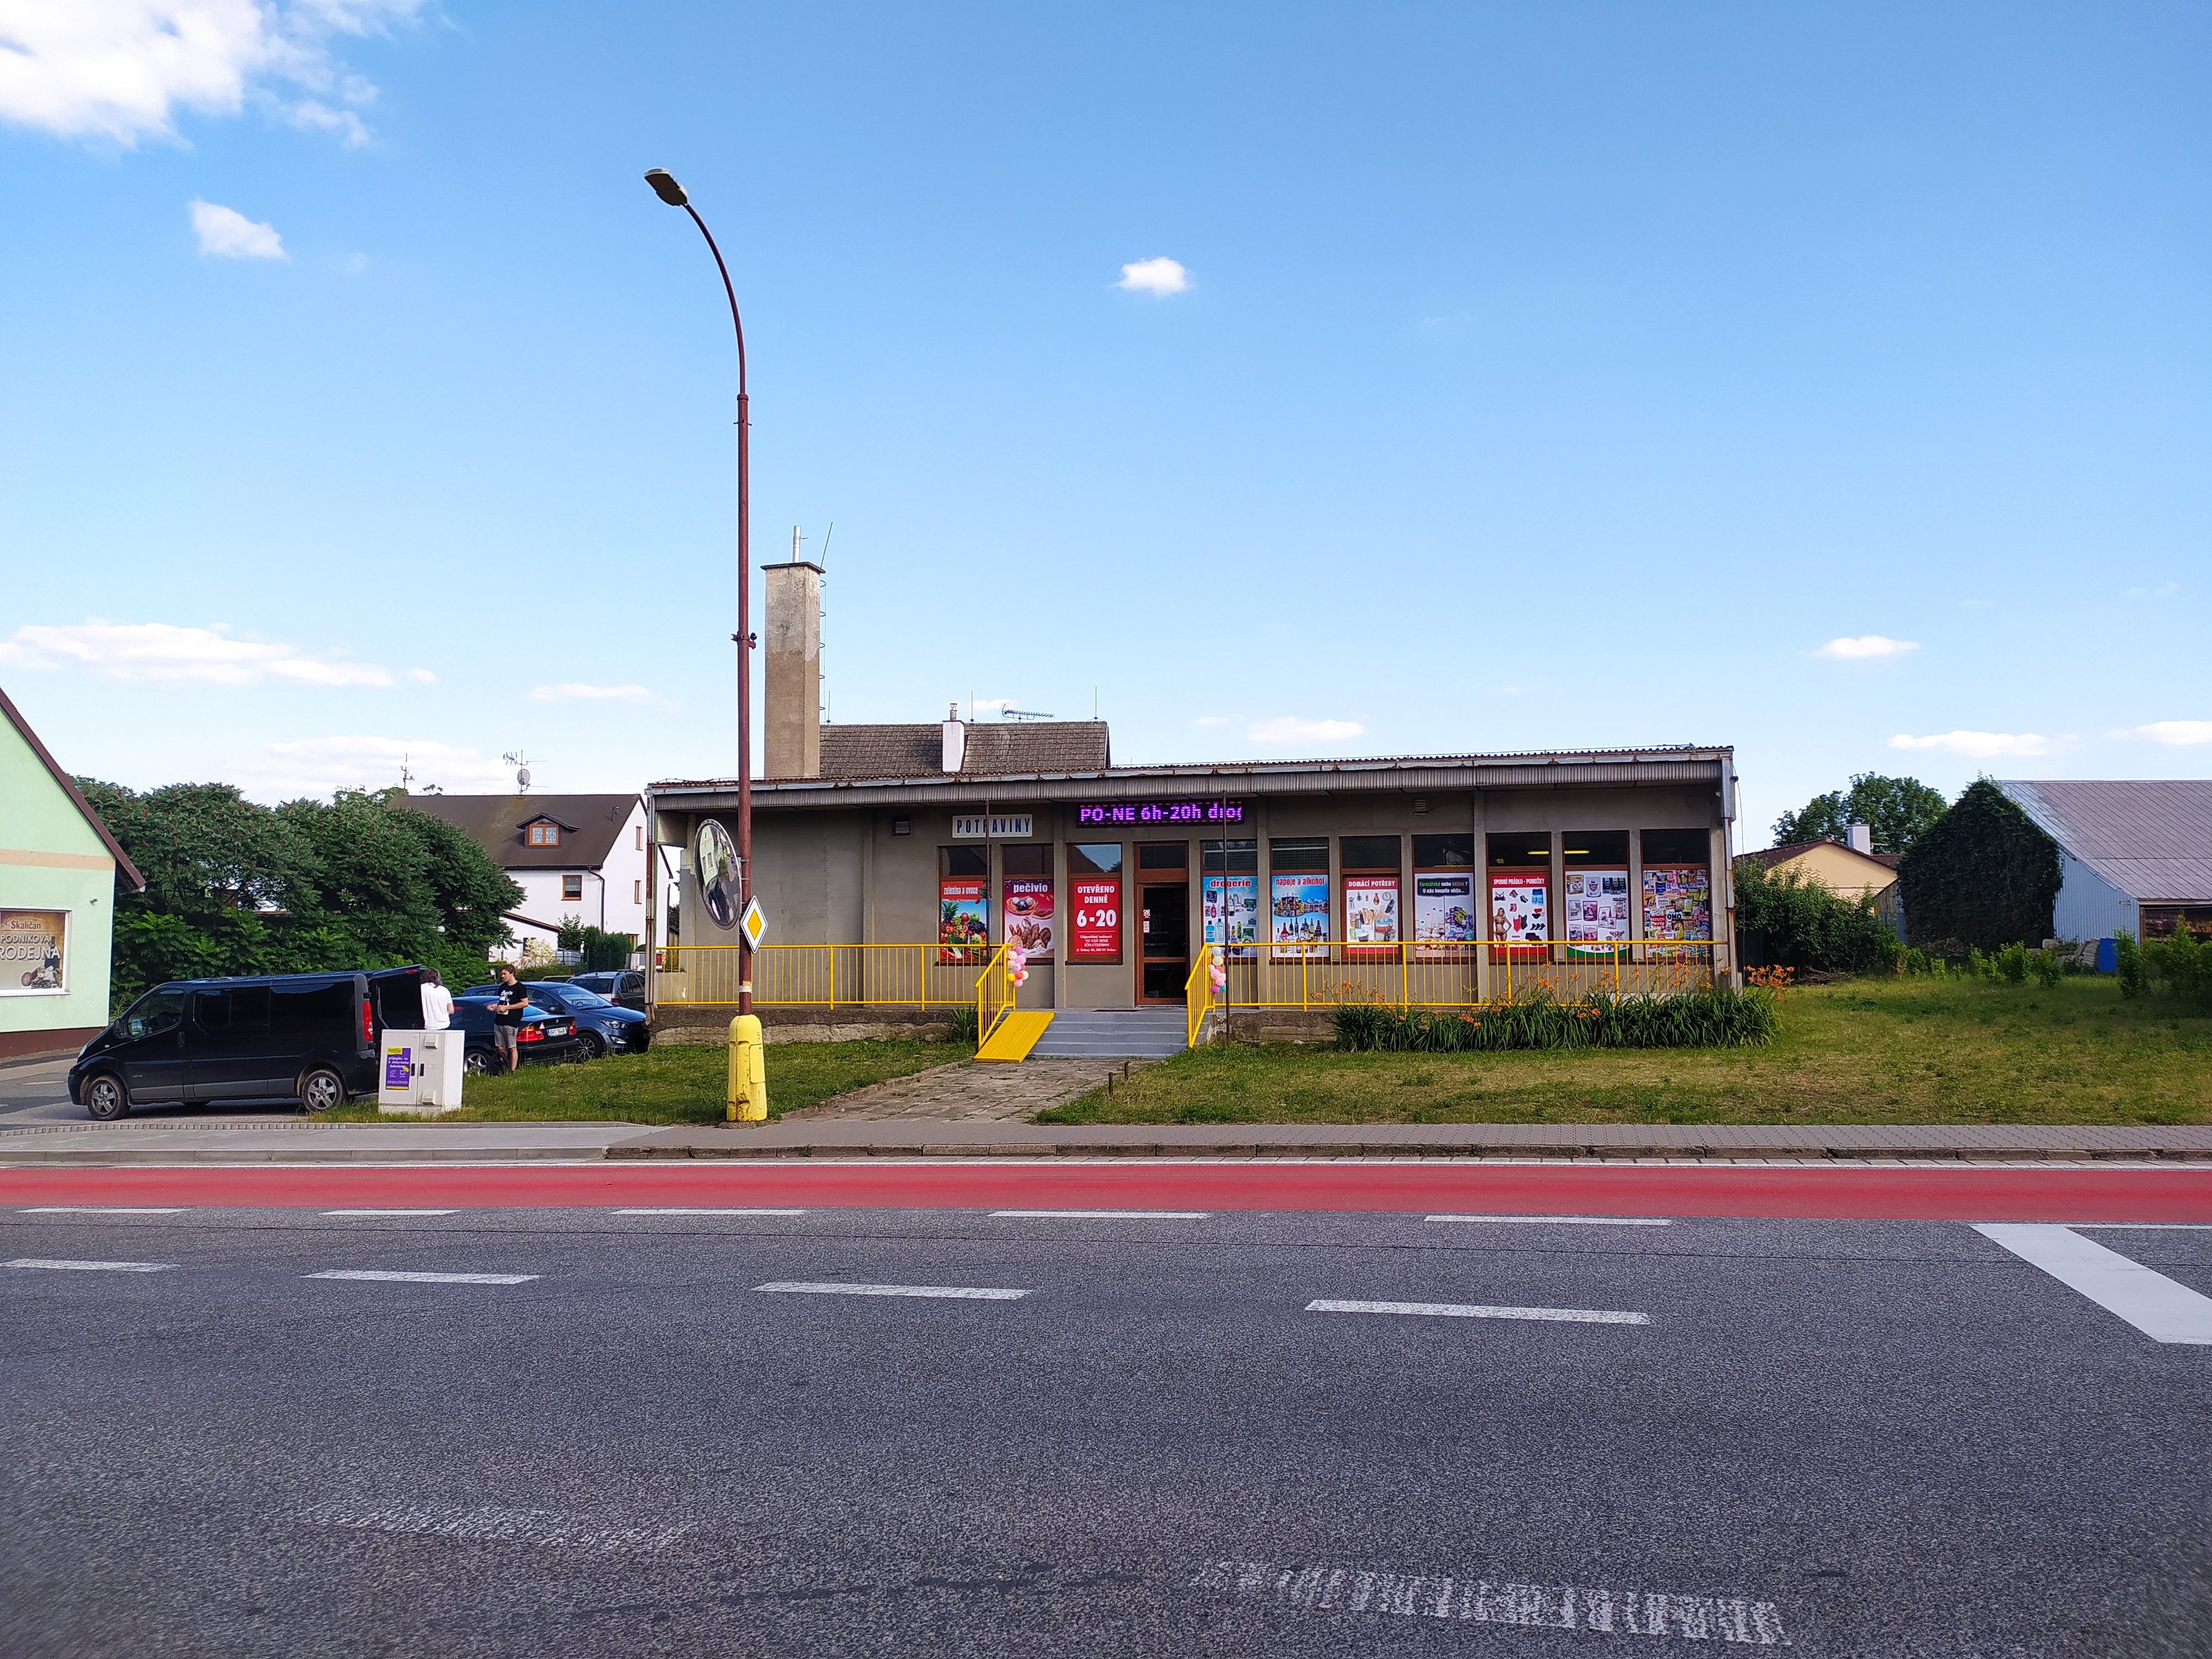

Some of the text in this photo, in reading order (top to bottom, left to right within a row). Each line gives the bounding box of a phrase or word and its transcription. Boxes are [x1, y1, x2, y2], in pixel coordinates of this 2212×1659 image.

[1081, 807, 1135, 822] PO-NE
[1141, 805, 1201, 820] 6h-20h
[1077, 884, 1115, 893] OTEVŘENO
[1084, 894, 1108, 903] DENNĚ
[11, 921, 41, 929] Skaličan
[1, 933, 49, 943] PODNIKOVÁ
